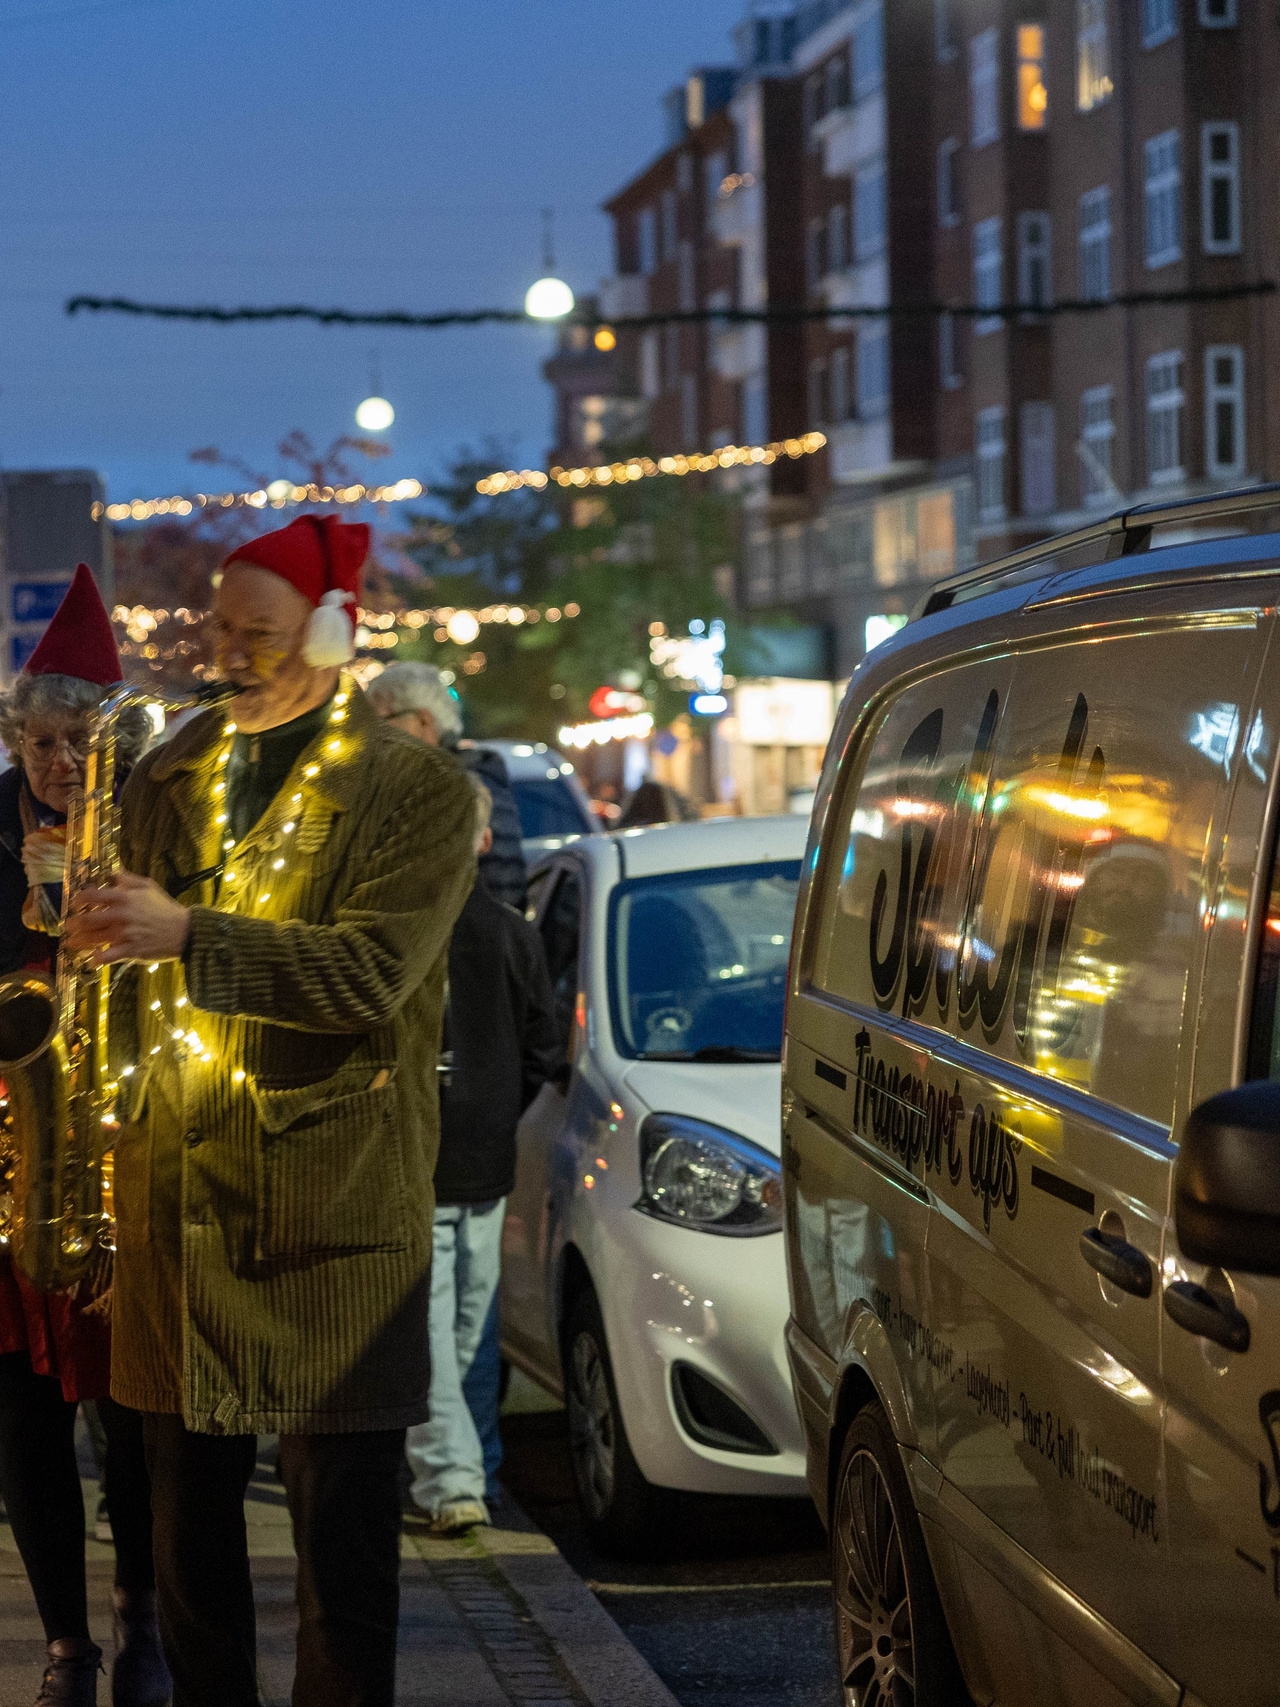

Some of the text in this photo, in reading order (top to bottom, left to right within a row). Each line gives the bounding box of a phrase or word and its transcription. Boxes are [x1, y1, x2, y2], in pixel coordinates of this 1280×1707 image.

[852, 1026, 965, 1186] Transport
[1020, 1392, 1044, 1455] Part
[1046, 1411, 1056, 1464] &
